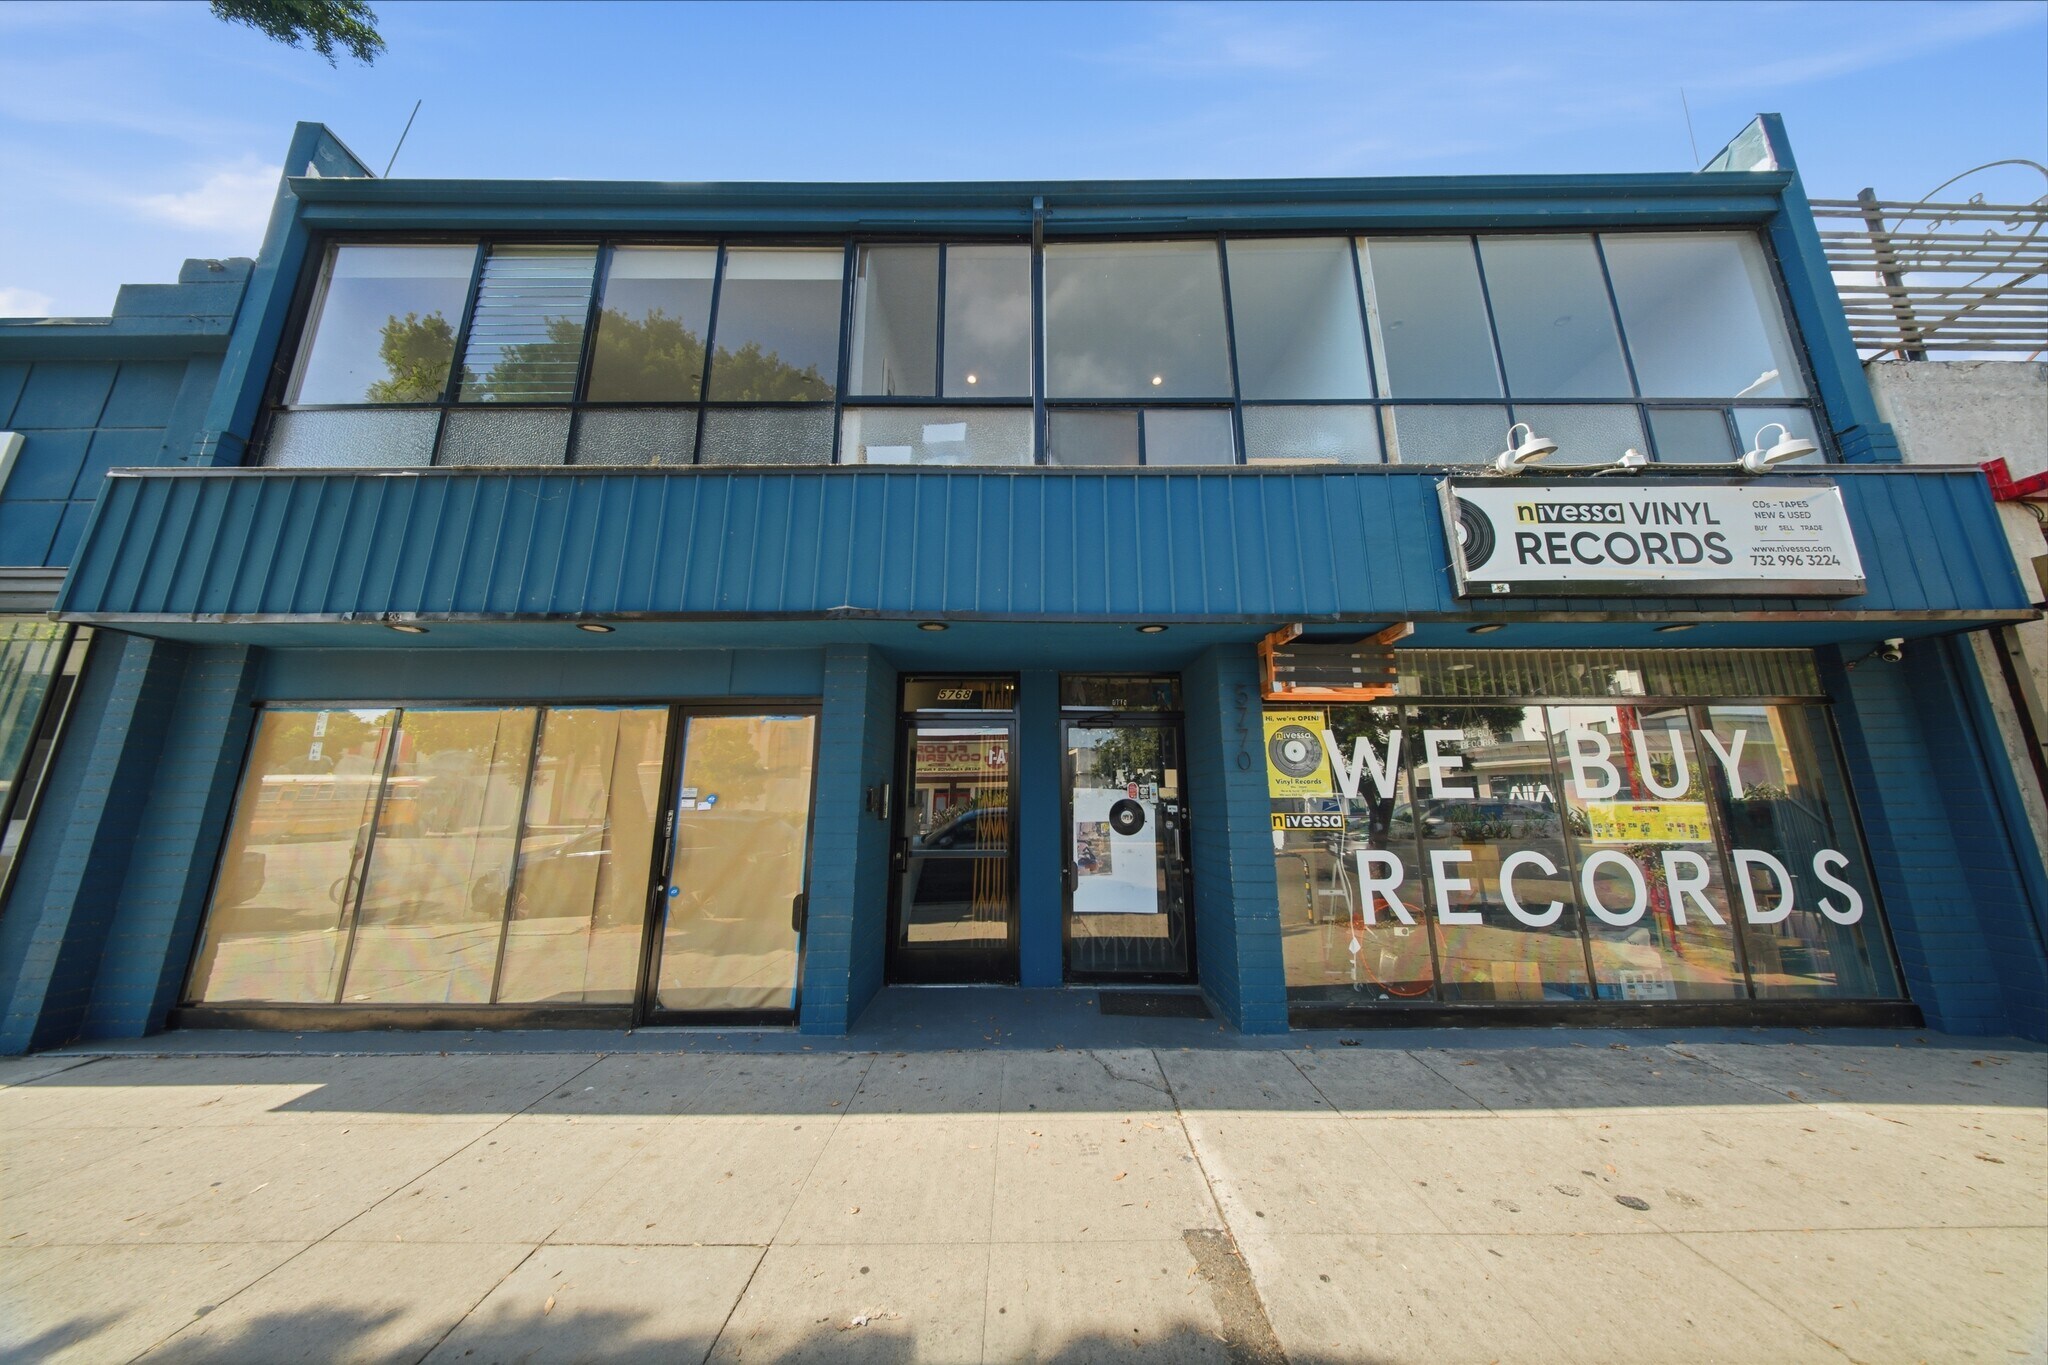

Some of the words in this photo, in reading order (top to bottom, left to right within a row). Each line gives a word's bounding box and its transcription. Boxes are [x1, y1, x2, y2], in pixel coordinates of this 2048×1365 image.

[1516, 503, 1622, 523] nivessa
[1629, 502, 1720, 525] VINYL
[1779, 511, 1785, 519] &
[1787, 511, 1811, 519] USED
[1515, 531, 1733, 565] RECORDS
[1750, 555, 1776, 566] 732
[1778, 555, 1803, 566] 996
[1806, 555, 1840, 566] 3224
[939, 689, 971, 699] 5768
[1276, 732, 1311, 740] nivessa
[1460, 738, 1499, 749] RECORDS
[1321, 729, 1475, 799] WE
[1570, 729, 1747, 799] BUY
[1272, 814, 1343, 829] nivessa
[1356, 849, 1864, 927] RECORDS
